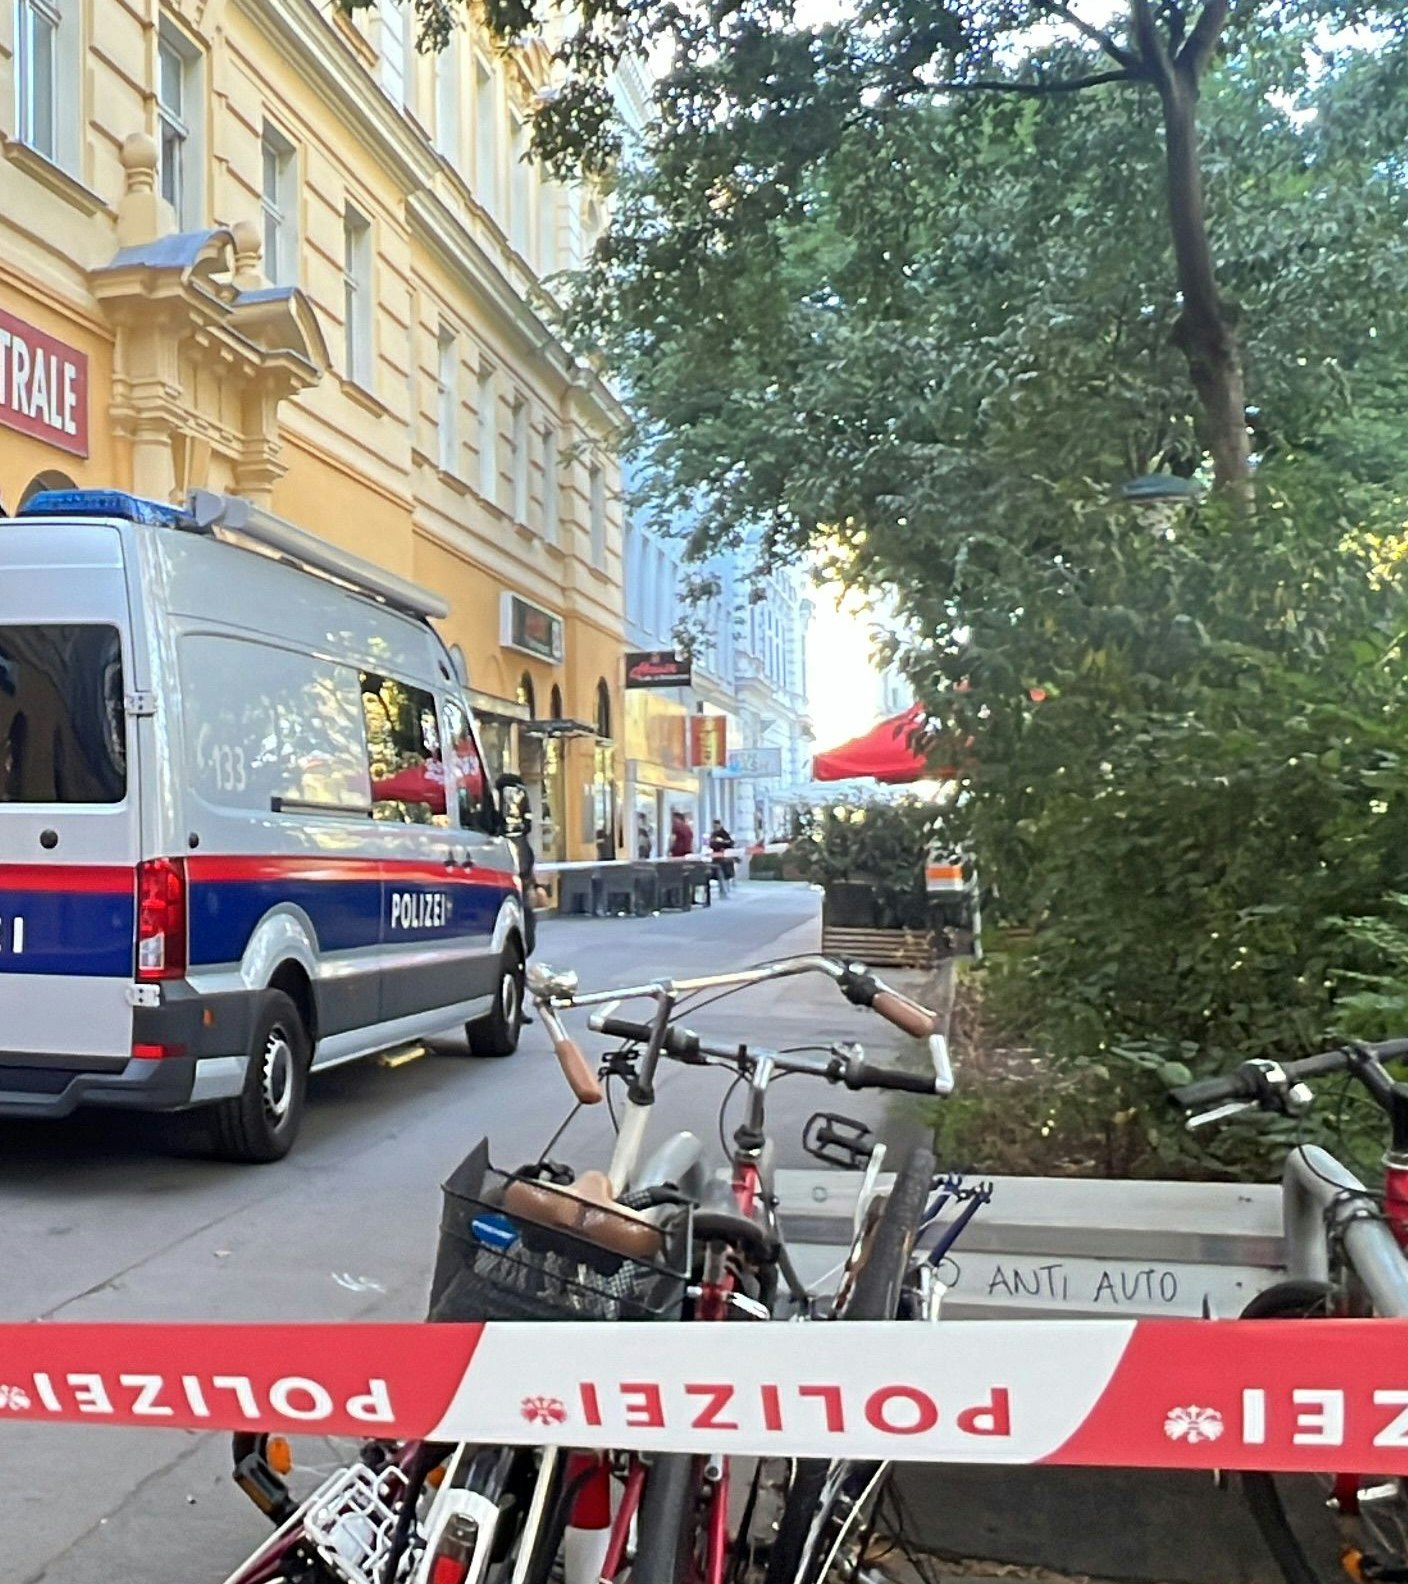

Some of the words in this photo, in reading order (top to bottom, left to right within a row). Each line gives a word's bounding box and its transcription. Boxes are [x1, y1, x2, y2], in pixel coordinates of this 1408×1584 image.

[391, 892, 446, 929] POLIZEI
[988, 1264, 1068, 1300] ANTI
[1093, 1269, 1178, 1304] AUTO
[33, 1371, 396, 1423] POLIZEI
[579, 1382, 1012, 1437] POLIZEI
